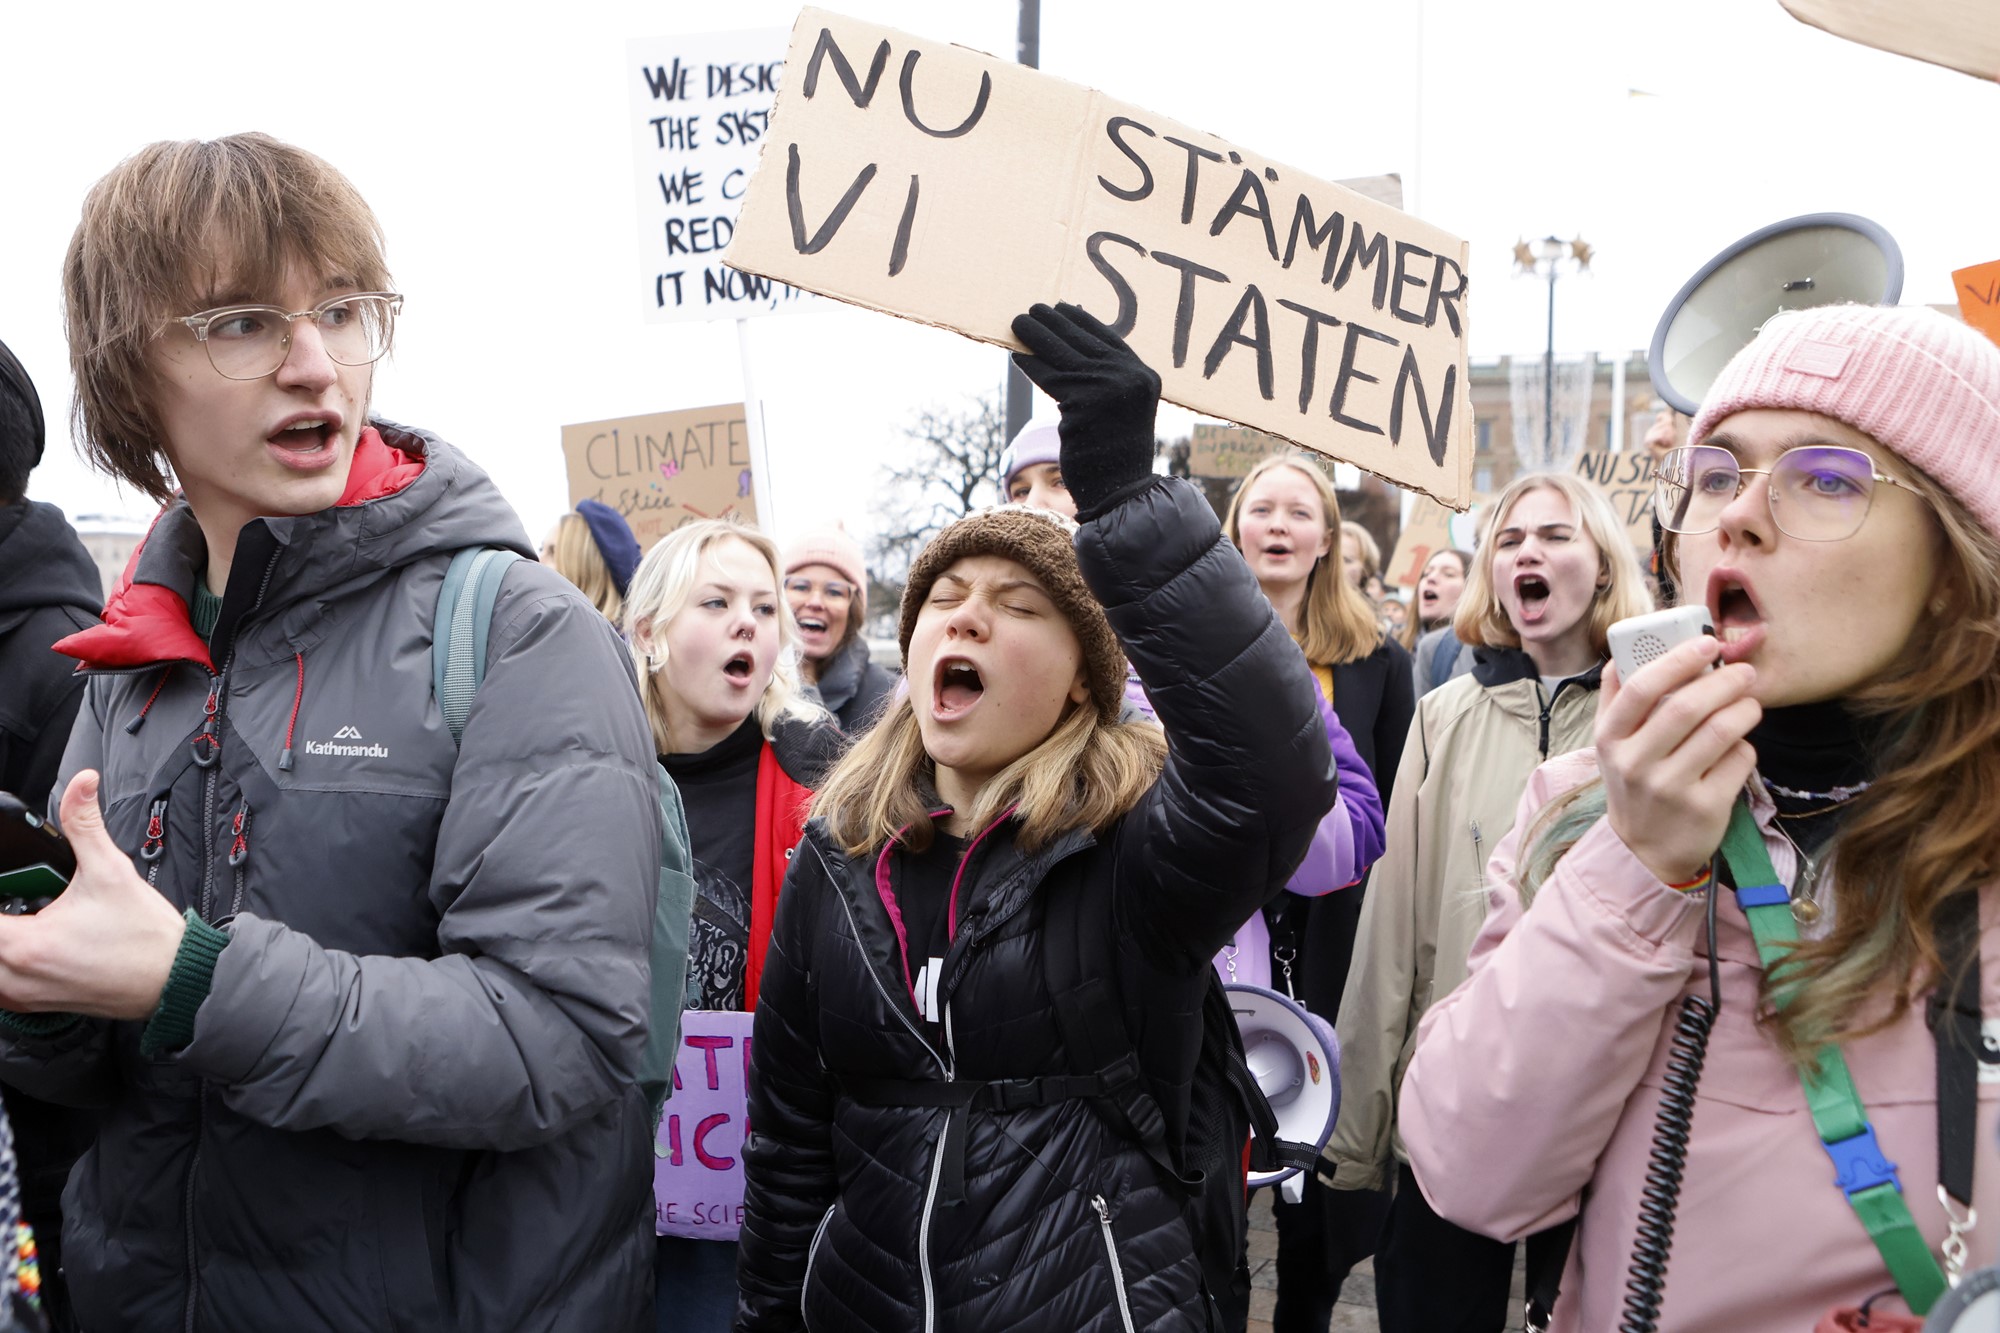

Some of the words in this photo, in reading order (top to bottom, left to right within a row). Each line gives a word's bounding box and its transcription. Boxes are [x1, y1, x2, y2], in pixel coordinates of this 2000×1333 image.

[642, 57, 697, 101] WE
[649, 116, 699, 151] THE
[659, 166, 704, 205] WE
[803, 28, 992, 138] NU
[1097, 116, 1469, 338] STÄMMER
[665, 217, 734, 256] RED
[656, 271, 686, 307] IT
[786, 142, 920, 278] VI
[1086, 231, 1456, 467] STATEN
[586, 419, 749, 480] CLIMATE
[1577, 453, 1619, 485] NU
[305, 741, 389, 758] Kathmandu
